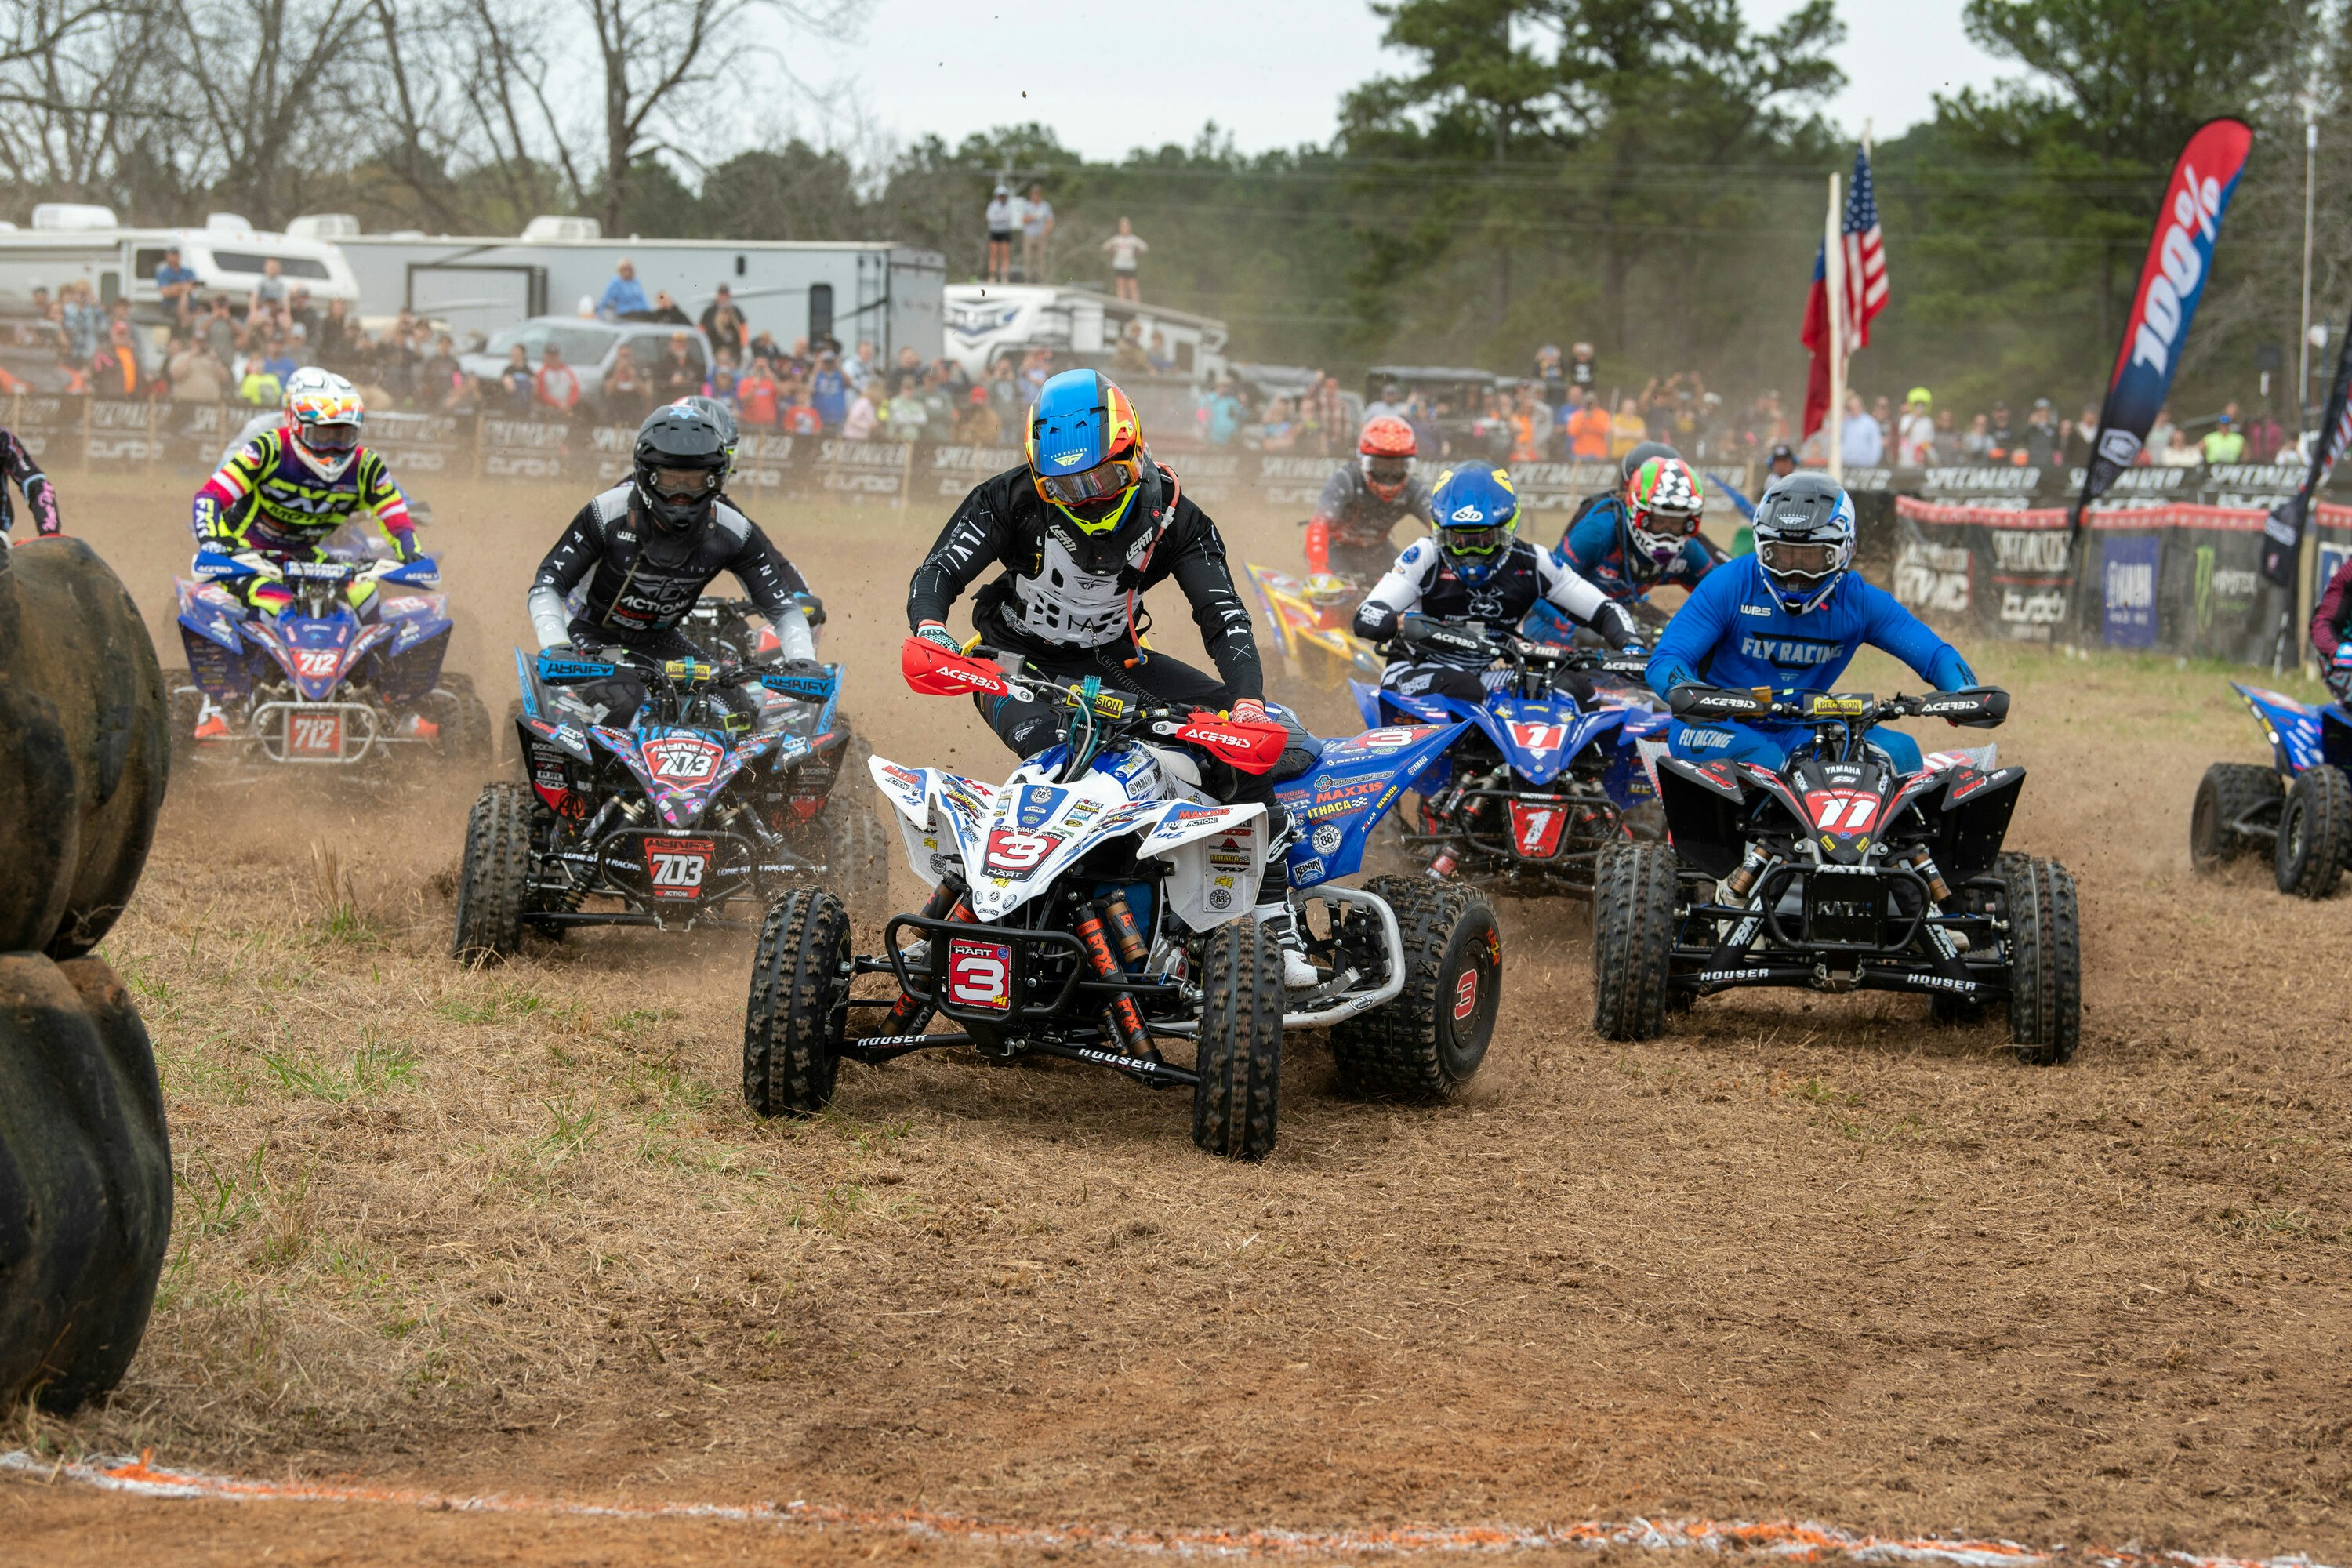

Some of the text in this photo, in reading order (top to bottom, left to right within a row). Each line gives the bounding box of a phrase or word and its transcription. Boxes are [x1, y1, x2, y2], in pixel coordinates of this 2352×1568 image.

[2133, 163, 2220, 377] 100%
[1925, 468, 2041, 490] SPECIALIZED
[1049, 524, 1077, 552] LEATT
[1126, 526, 1154, 561] LEATT
[620, 595, 687, 614] ACTION
[1432, 632, 1478, 649] ACERBIS
[1740, 637, 1844, 665] FLY RACING
[299, 652, 339, 673] 712
[935, 666, 1001, 691] ACERBIS
[1699, 696, 1757, 710] ACERBIS
[1921, 700, 1980, 713] ACERBIS
[293, 718, 336, 749] 712
[1184, 728, 1252, 749] ACERBIS
[1367, 730, 1414, 747] 3
[1526, 725, 1550, 748] 1
[1679, 728, 1735, 749] FLY RACING
[653, 751, 713, 778] 703
[1335, 754, 1374, 764] SCOTT
[1411, 755, 1428, 772] YAMAHA
[881, 764, 920, 785] MAXXIS
[1824, 764, 1861, 776] YAMAHA
[886, 777, 910, 790] ACTION
[1134, 774, 1154, 792] YAMAHA
[1316, 782, 1384, 804] MAXXIS
[1376, 785, 1398, 810] HINSON
[1178, 808, 1231, 820] MAXXIS
[1307, 800, 1352, 819] ITHACA
[1310, 811, 1346, 826] RECREATION
[1817, 798, 1878, 829] 11
[1185, 817, 1212, 827] ACTION
[1361, 811, 1377, 833] POLAR
[1523, 809, 1552, 845] 1
[1313, 826, 1341, 847] FORMULA
[1320, 833, 1334, 846] 88
[564, 852, 641, 871] LONE RACING
[987, 834, 1049, 869] 3
[651, 854, 705, 887] 703
[717, 867, 737, 877] LONE
[987, 868, 1023, 878] HART
[1815, 864, 1878, 877] RATH
[664, 889, 688, 898] ACTION
[1215, 895, 1225, 903] 88
[955, 947, 993, 956] HART
[1086, 931, 1116, 976] FOX
[953, 956, 1005, 1002] 3
[1700, 968, 1769, 982] HOUSER
[1907, 974, 1976, 991] HOUSER
[894, 993, 917, 1017] FO
[1454, 968, 1478, 1021] 3
[1117, 996, 1142, 1035] FOX
[857, 1034, 927, 1047] HOUSER
[1078, 1047, 1158, 1072] HOUSER
